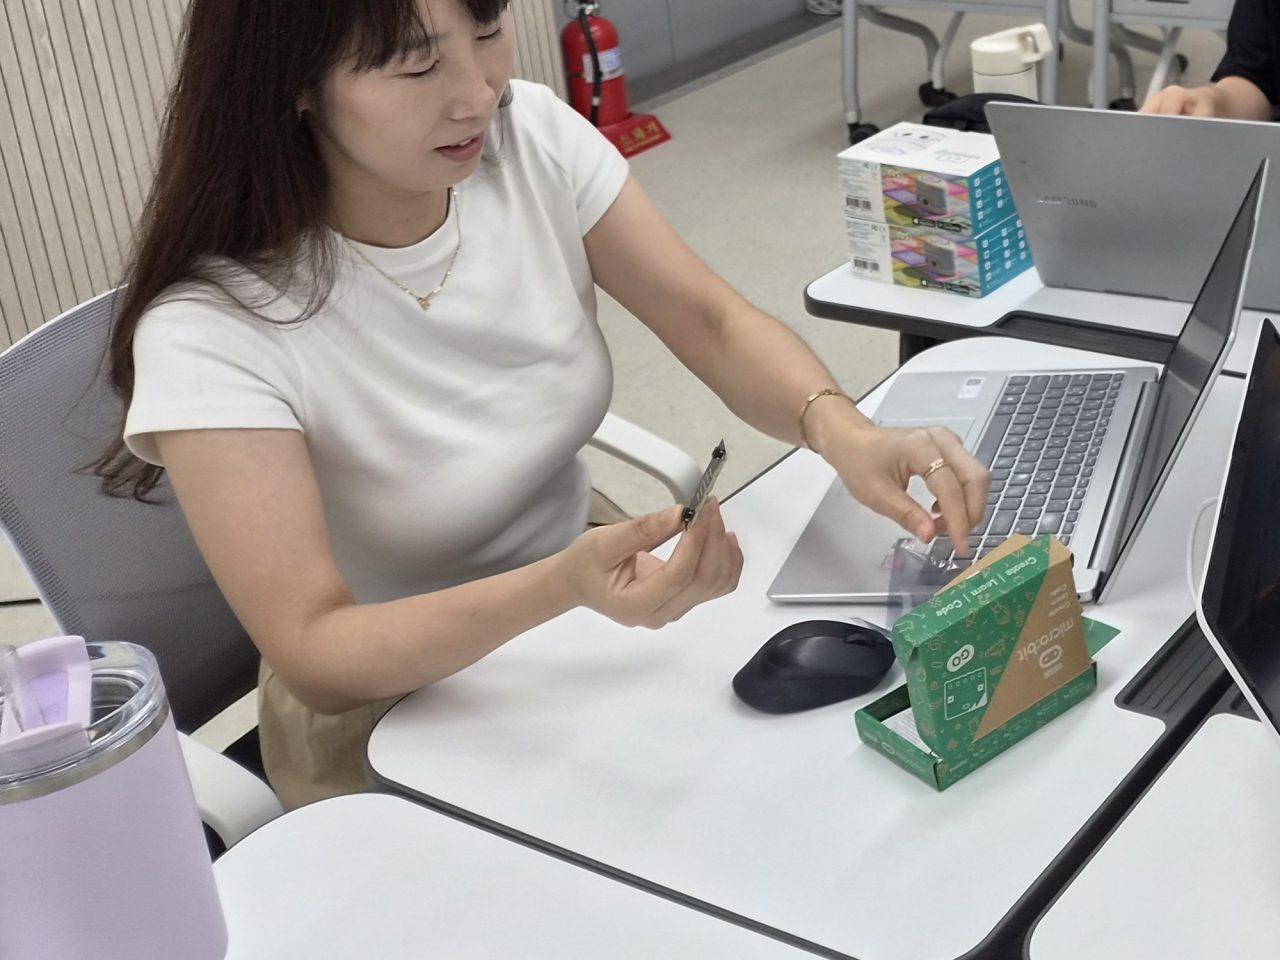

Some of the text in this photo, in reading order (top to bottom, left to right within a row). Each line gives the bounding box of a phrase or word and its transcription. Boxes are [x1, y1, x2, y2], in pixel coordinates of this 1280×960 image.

[935, 556, 1037, 617] Create Learn Code
[952, 649, 970, 667] GO
[1017, 617, 1074, 662] micro:bit
